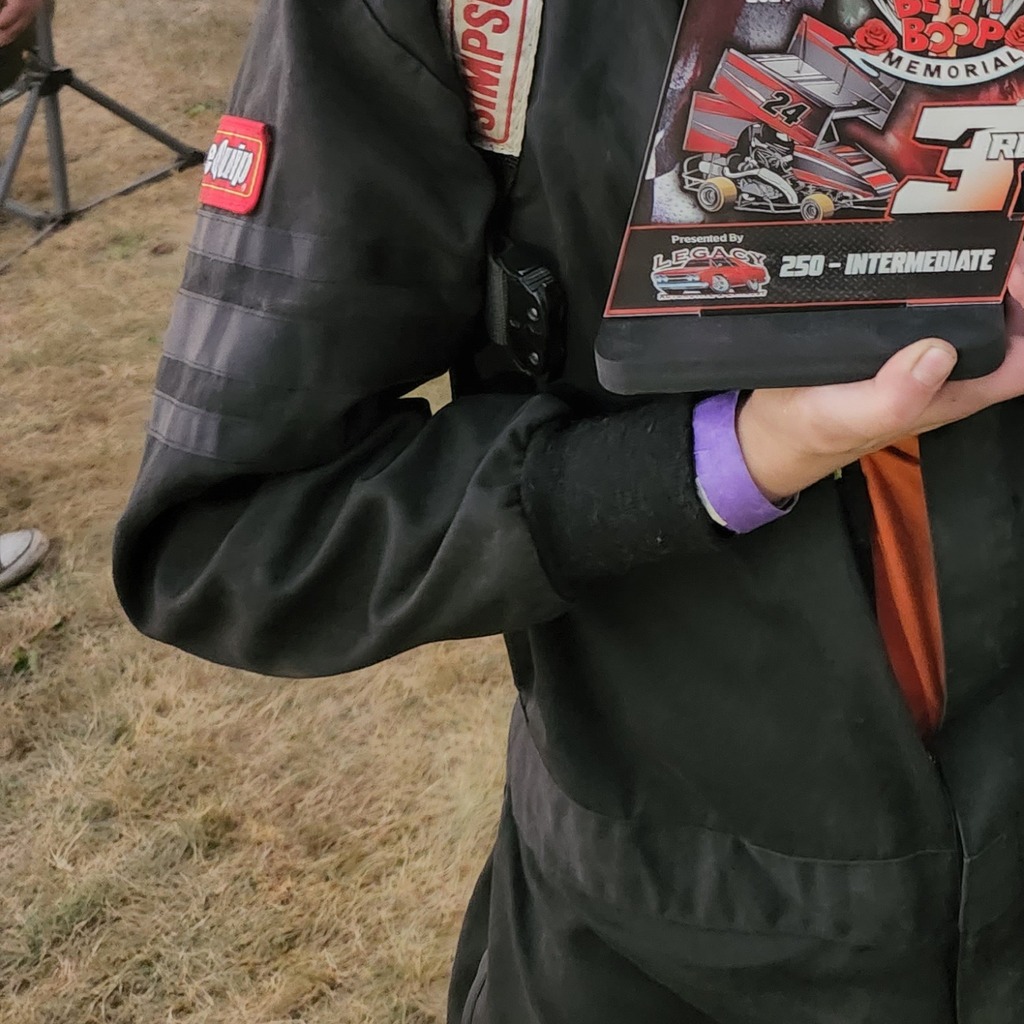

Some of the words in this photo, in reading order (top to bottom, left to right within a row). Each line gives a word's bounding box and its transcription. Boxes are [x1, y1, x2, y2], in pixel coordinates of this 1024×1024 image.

[902, 14, 1006, 54] BOOP
[882, 50, 1024, 79] MEMORIAL
[760, 90, 812, 127] 24
[671, 234, 727, 244] Presented
[729, 233, 745, 244] By
[651, 246, 767, 272] LEGACY
[779, 254, 825, 277] 250
[844, 248, 997, 276] INTERMEDIATE
